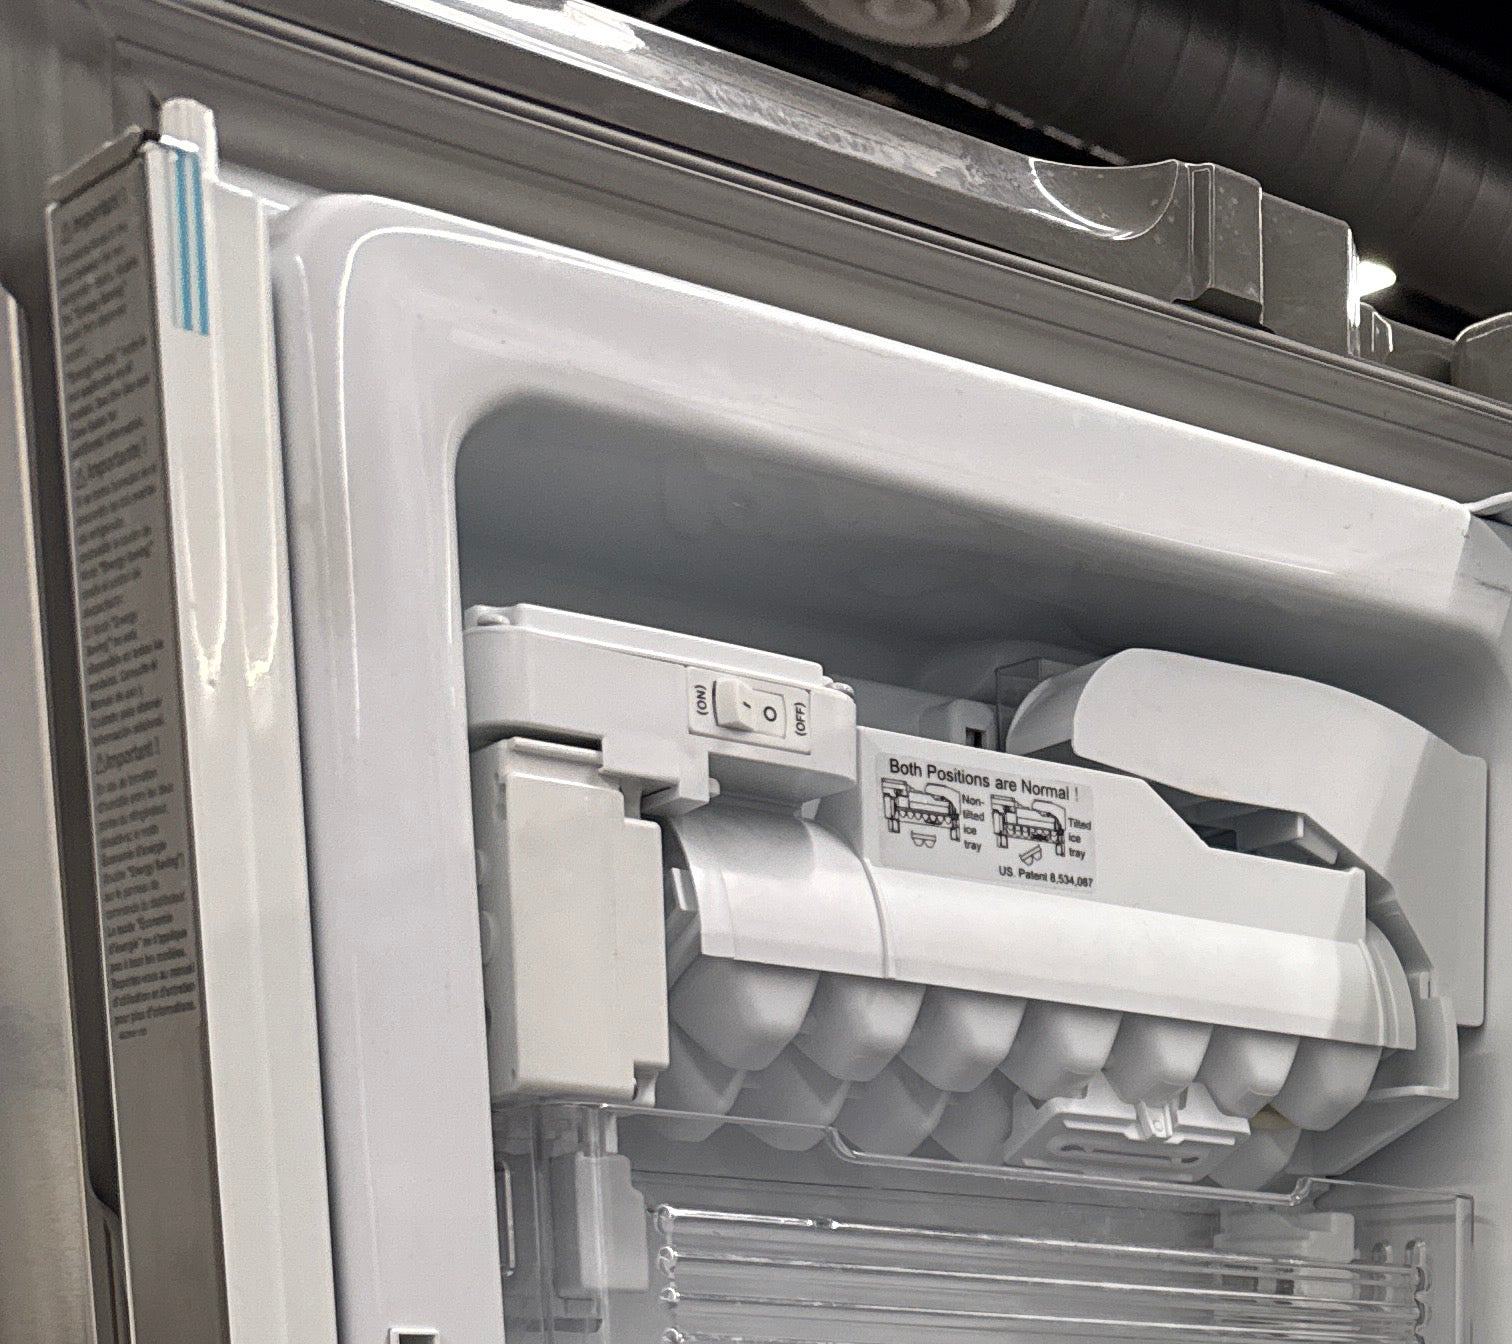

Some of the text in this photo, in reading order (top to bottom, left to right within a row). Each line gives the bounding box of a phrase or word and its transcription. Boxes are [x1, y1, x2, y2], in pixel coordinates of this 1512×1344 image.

[694, 684, 709, 715] (ON)
[794, 702, 807, 736] (OFF)
[889, 758, 922, 778] Both
[927, 764, 990, 788] Positions
[995, 776, 1017, 792] are
[1021, 779, 1069, 801] Normal
[963, 823, 977, 836] ice
[1068, 833, 1081, 844] ice
[964, 839, 982, 853] tray
[1069, 847, 1086, 861] tray
[1018, 869, 1048, 882] Patent
